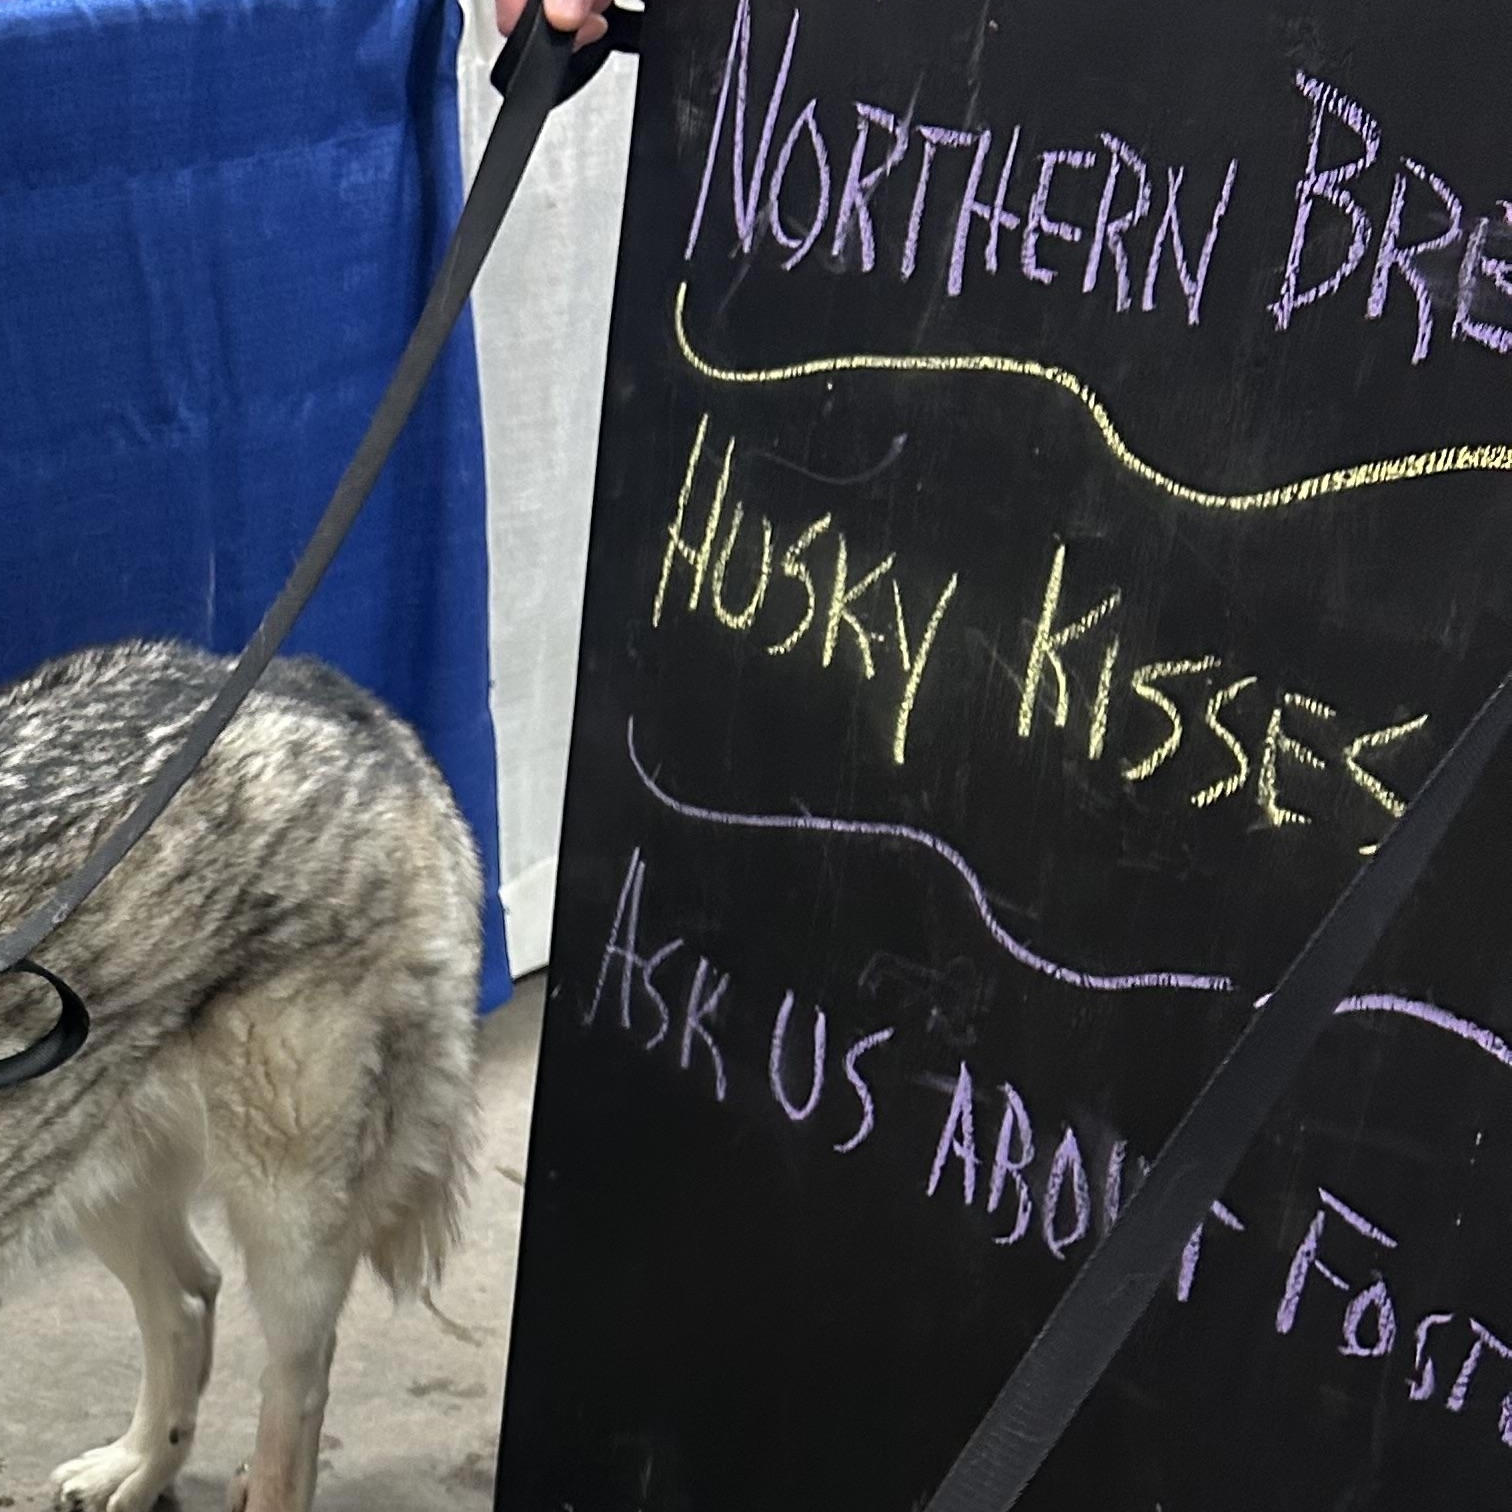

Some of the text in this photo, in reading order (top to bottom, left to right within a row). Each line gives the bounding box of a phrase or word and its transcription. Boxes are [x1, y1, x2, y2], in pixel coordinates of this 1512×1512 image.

[687, 0, 1238, 325] NORTHERN
[653, 414, 1429, 856] HUSKY KISSES
[583, 847, 728, 1101] ASK
[769, 989, 895, 1153] US
[1275, 1187, 1512, 1448] FOST
